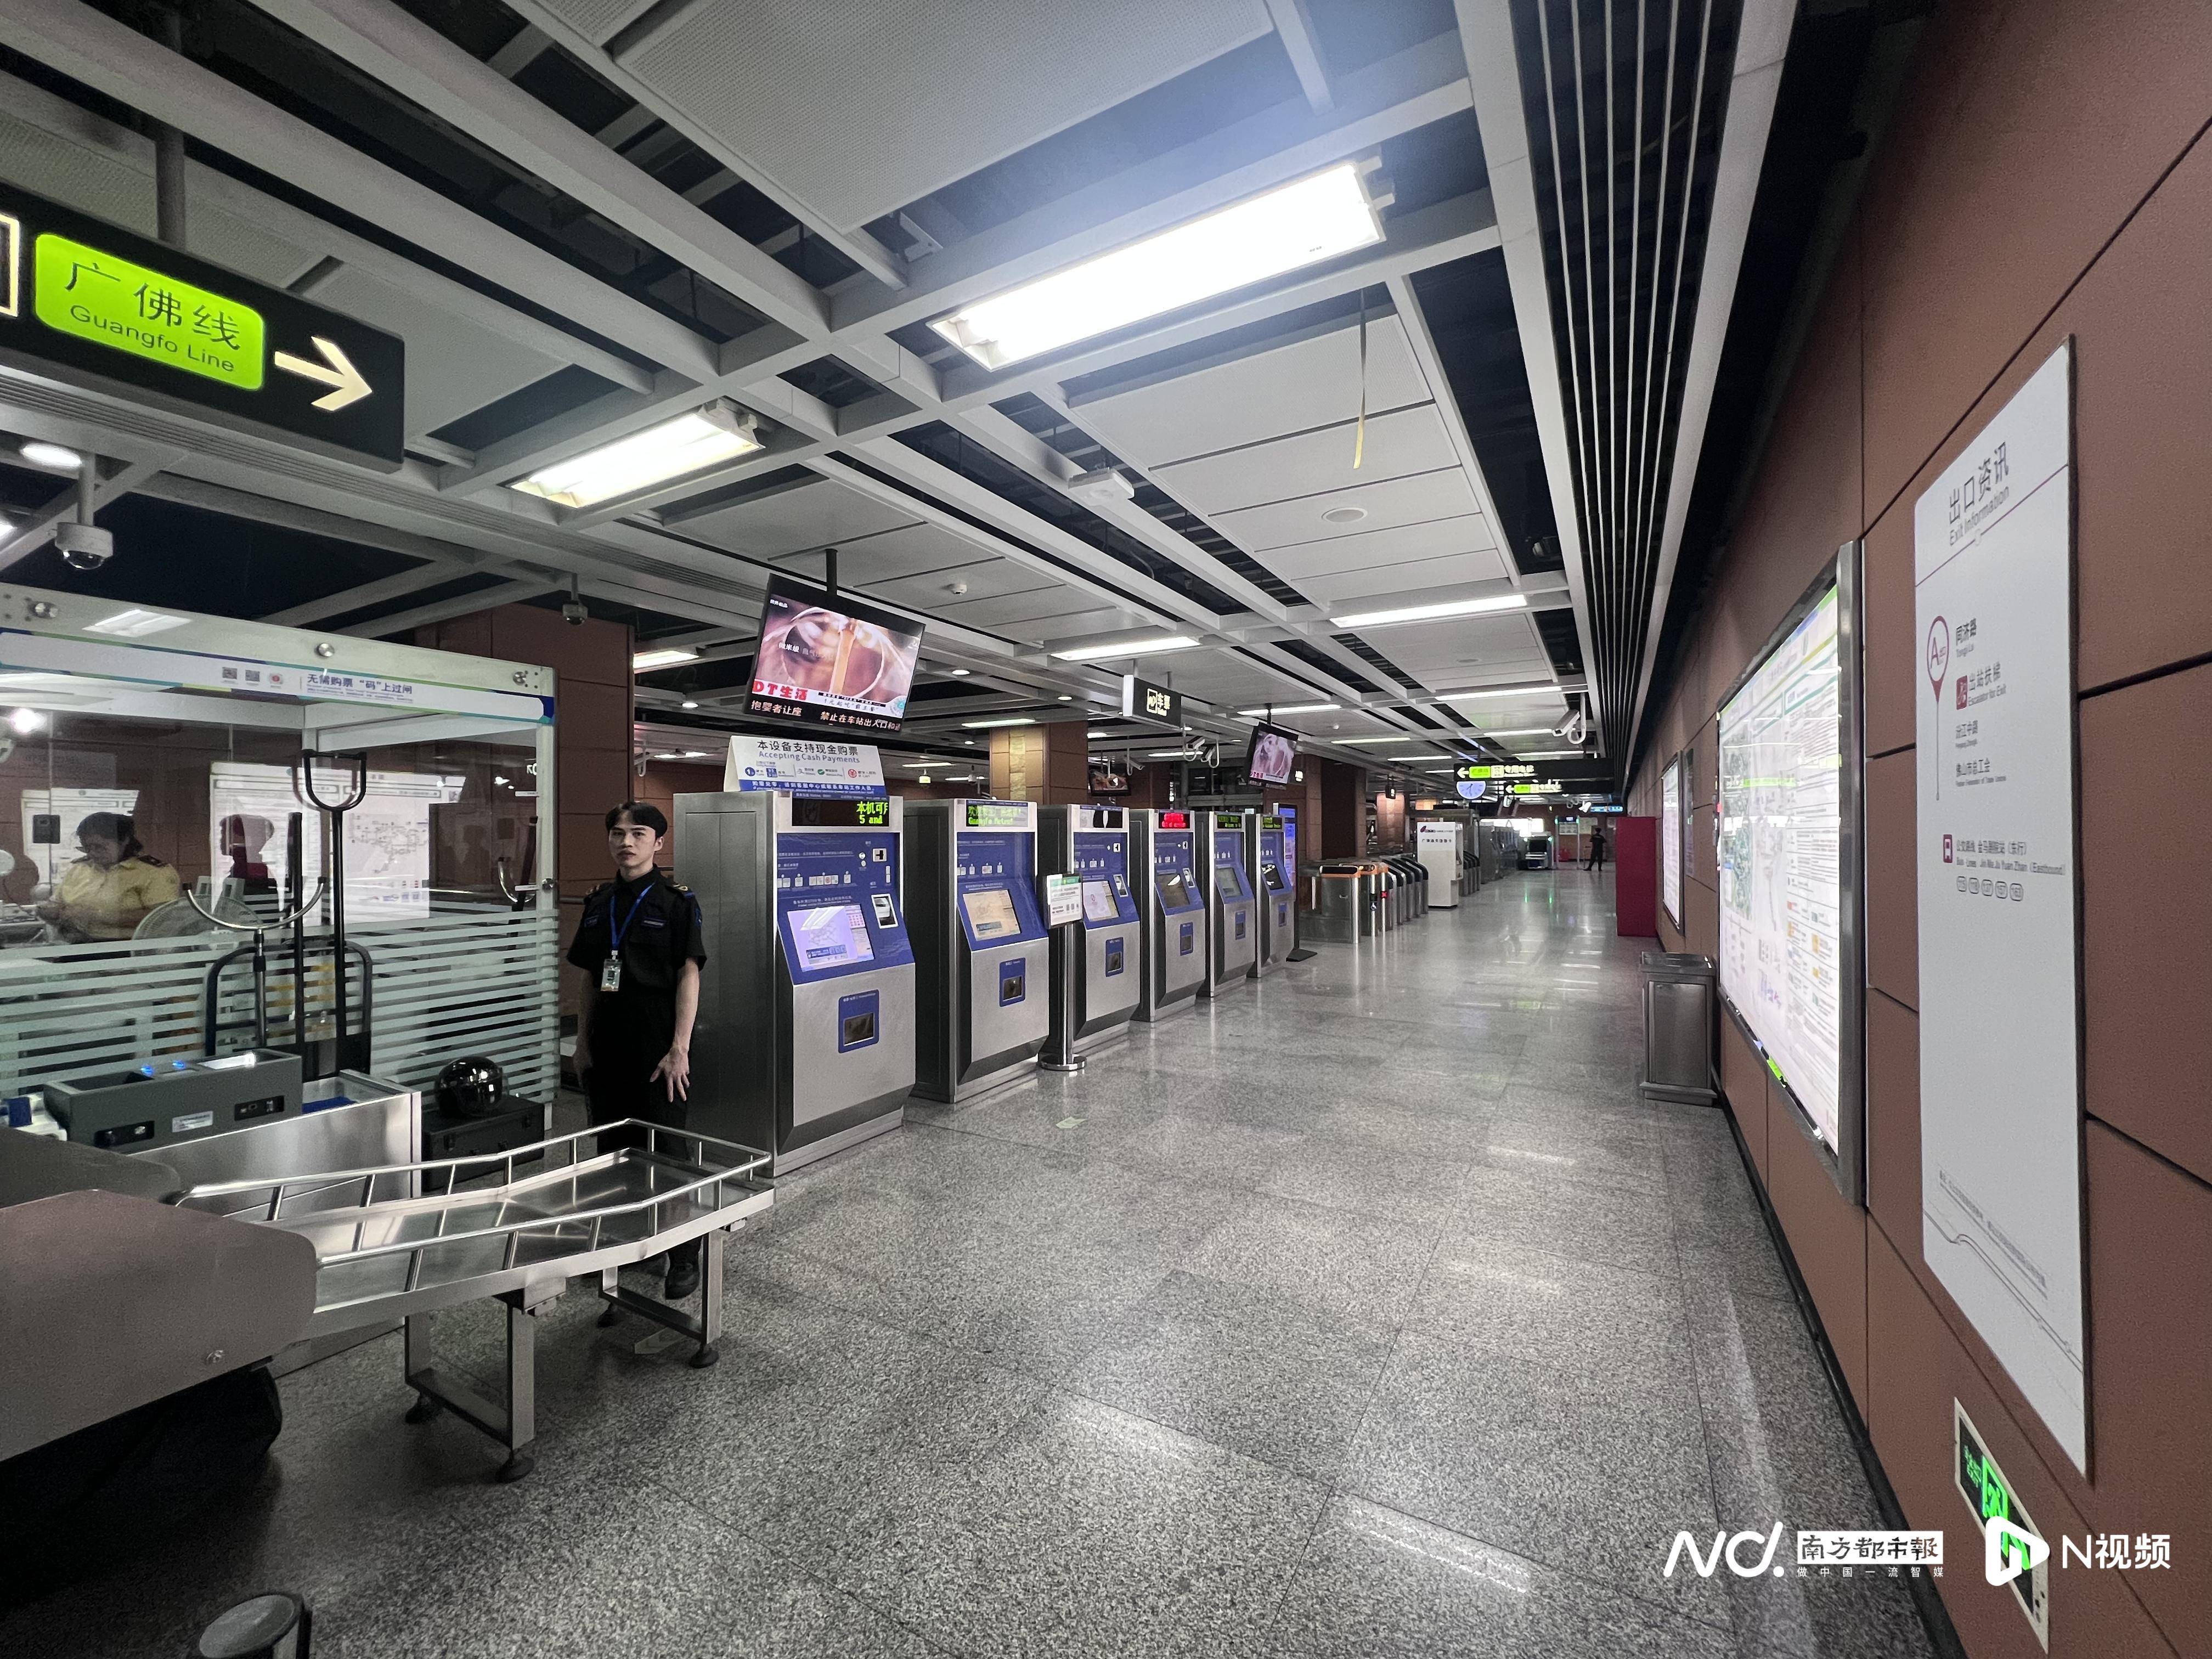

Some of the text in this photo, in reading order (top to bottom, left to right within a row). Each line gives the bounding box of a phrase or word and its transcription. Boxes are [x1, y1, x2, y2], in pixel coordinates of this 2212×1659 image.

[65, 261, 241, 351] 广佛线
[70, 304, 235, 373] Guangfo Line
[1949, 441, 2010, 525] 出口资讯
[757, 740, 860, 756] 本设备支持现金购票
[759, 751, 860, 764] Accepting Cash Payments
[868, 815, 883, 824] and
